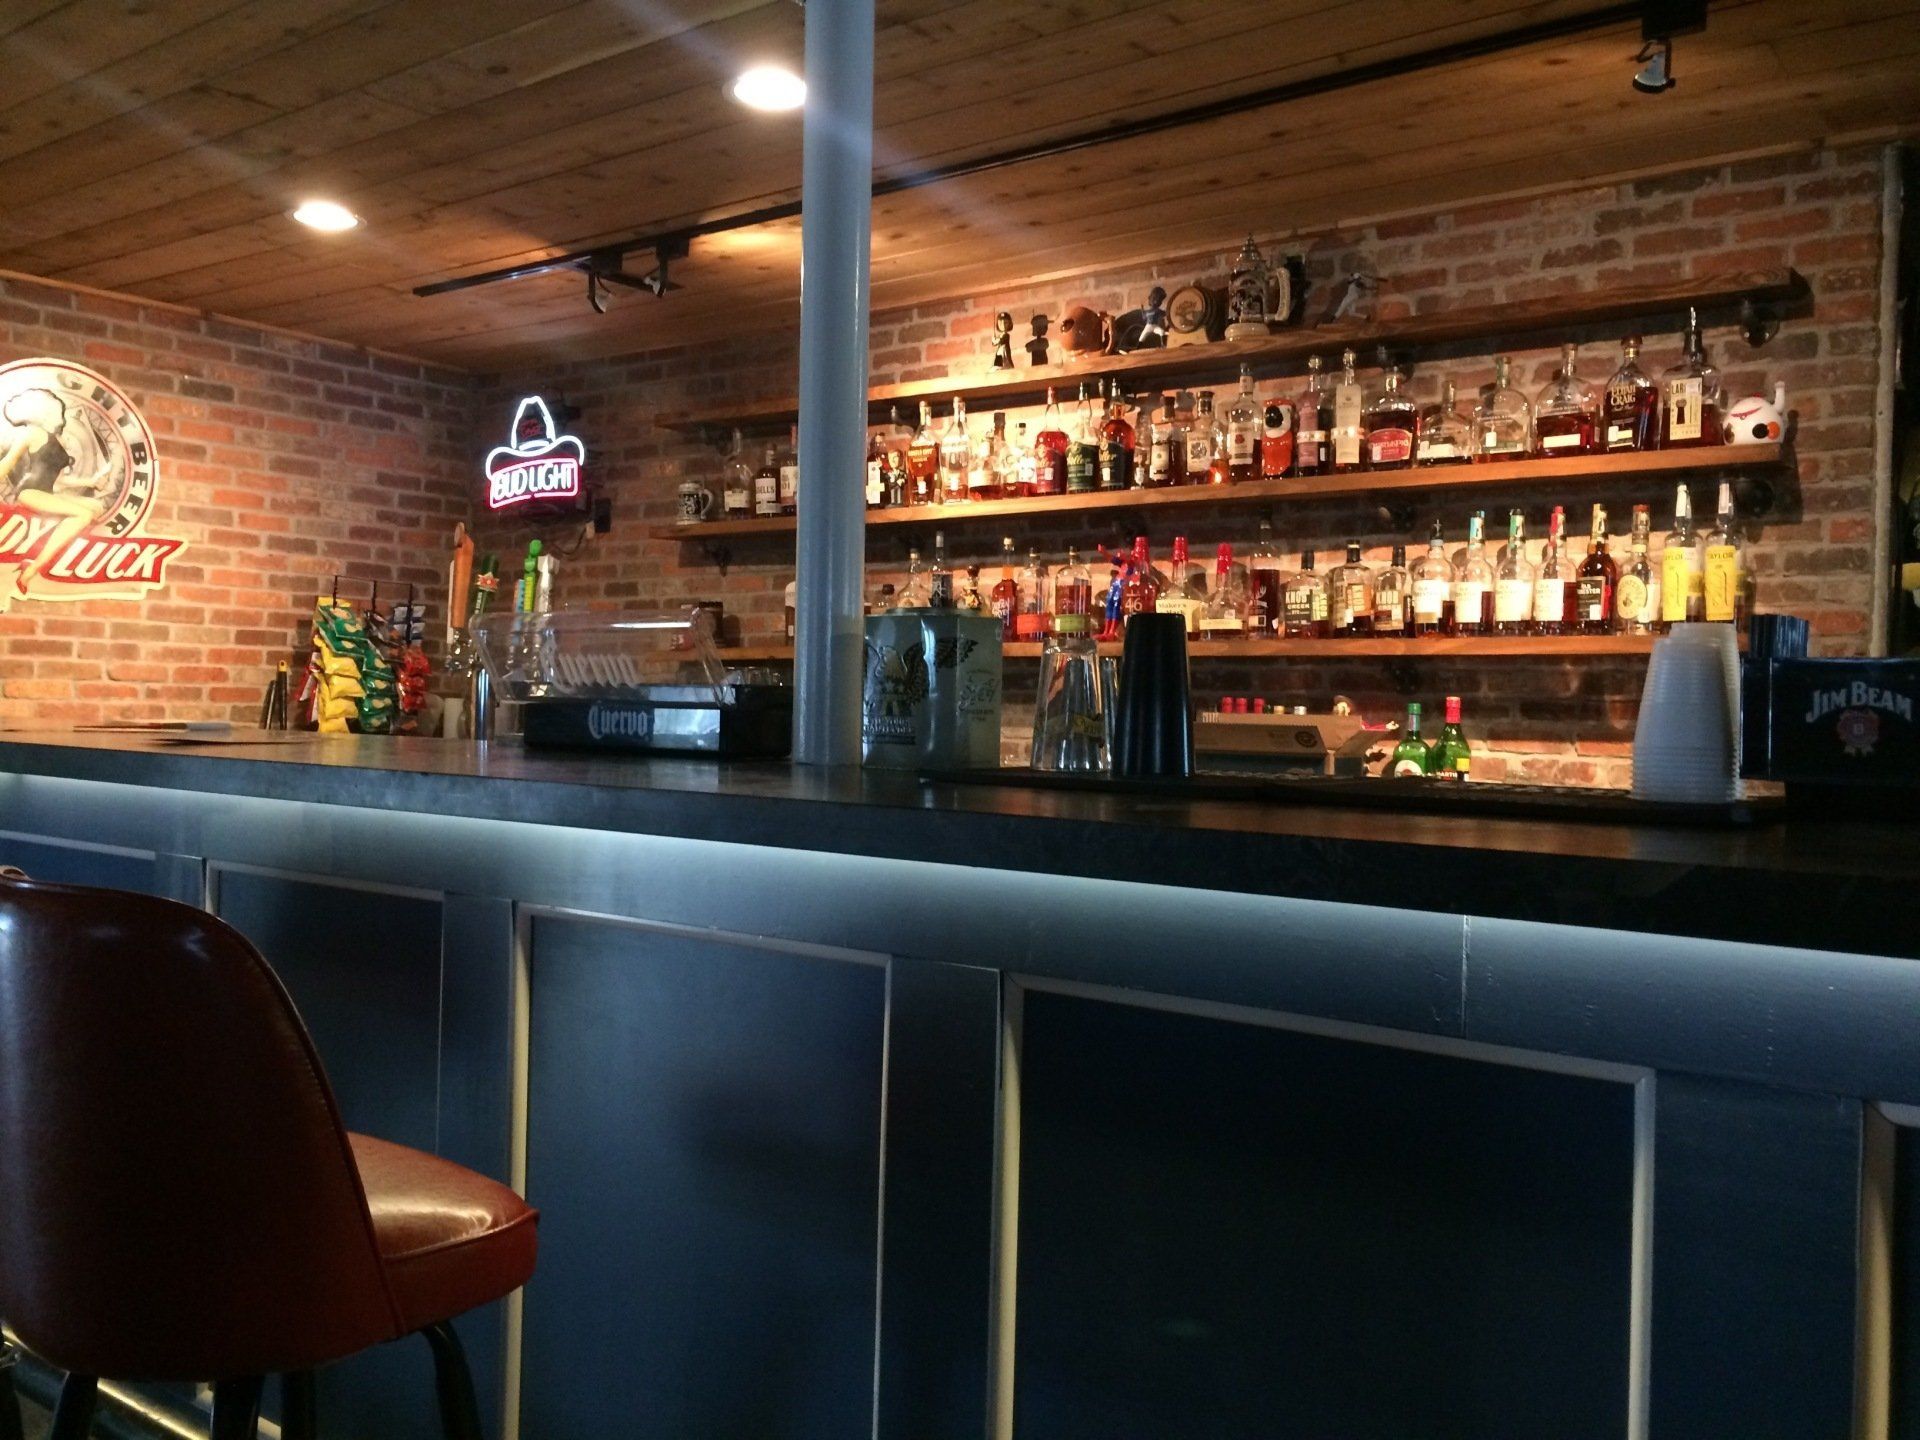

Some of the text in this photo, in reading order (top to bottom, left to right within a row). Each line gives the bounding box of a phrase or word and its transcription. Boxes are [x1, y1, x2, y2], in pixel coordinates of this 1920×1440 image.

[1611, 394, 1636, 406] CRAIG
[105, 441, 149, 536] BEER
[492, 462, 574, 500] BUD LIGHT
[50, 537, 171, 579] LUCK
[1124, 597, 1143, 612] 46
[587, 703, 650, 740] Cuervo
[1805, 681, 1913, 724] JIM BEAM
